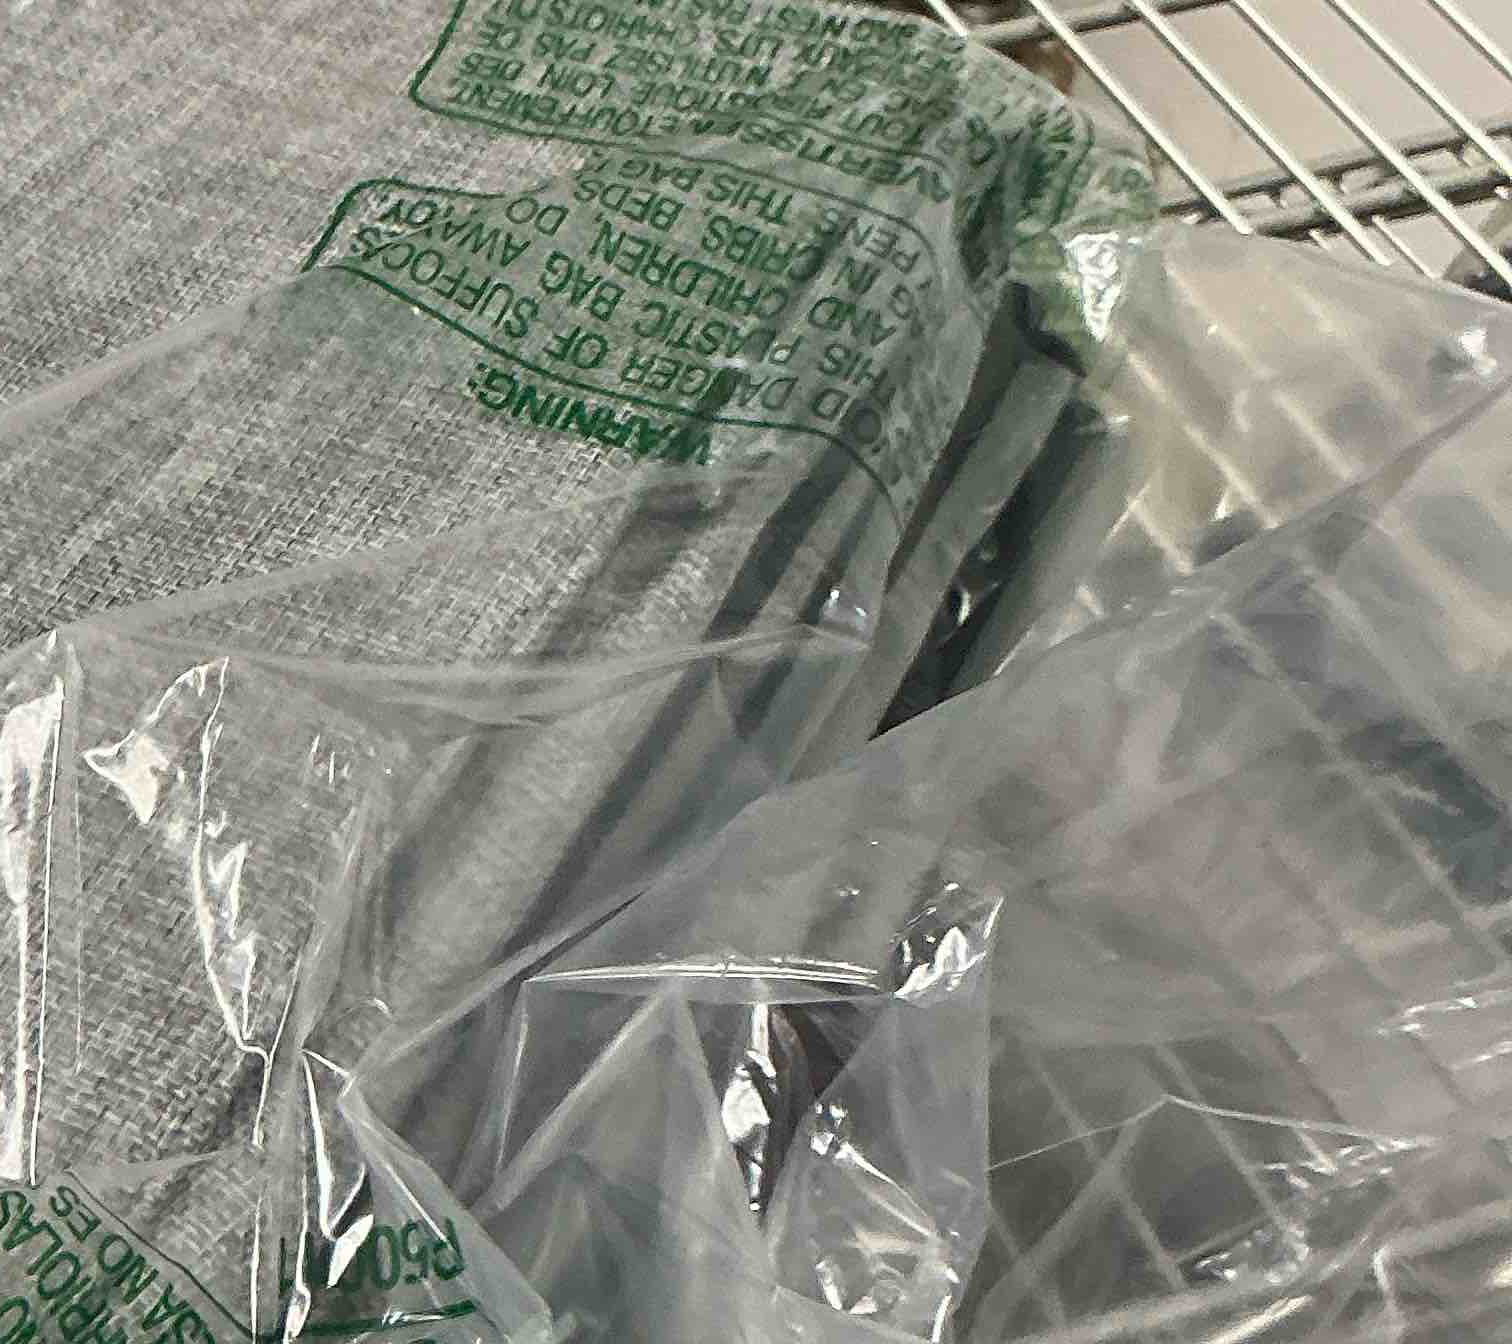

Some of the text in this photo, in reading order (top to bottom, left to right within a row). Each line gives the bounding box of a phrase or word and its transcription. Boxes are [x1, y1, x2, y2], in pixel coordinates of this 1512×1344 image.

[458, 51, 522, 83] DES
[619, 159, 702, 192] BAG
[707, 173, 793, 227] THIS
[503, 194, 568, 236] DO
[538, 249, 626, 321] BAG
[542, 323, 607, 369] OF
[42, 1169, 103, 1229] ES
[90, 1218, 162, 1293] NO
